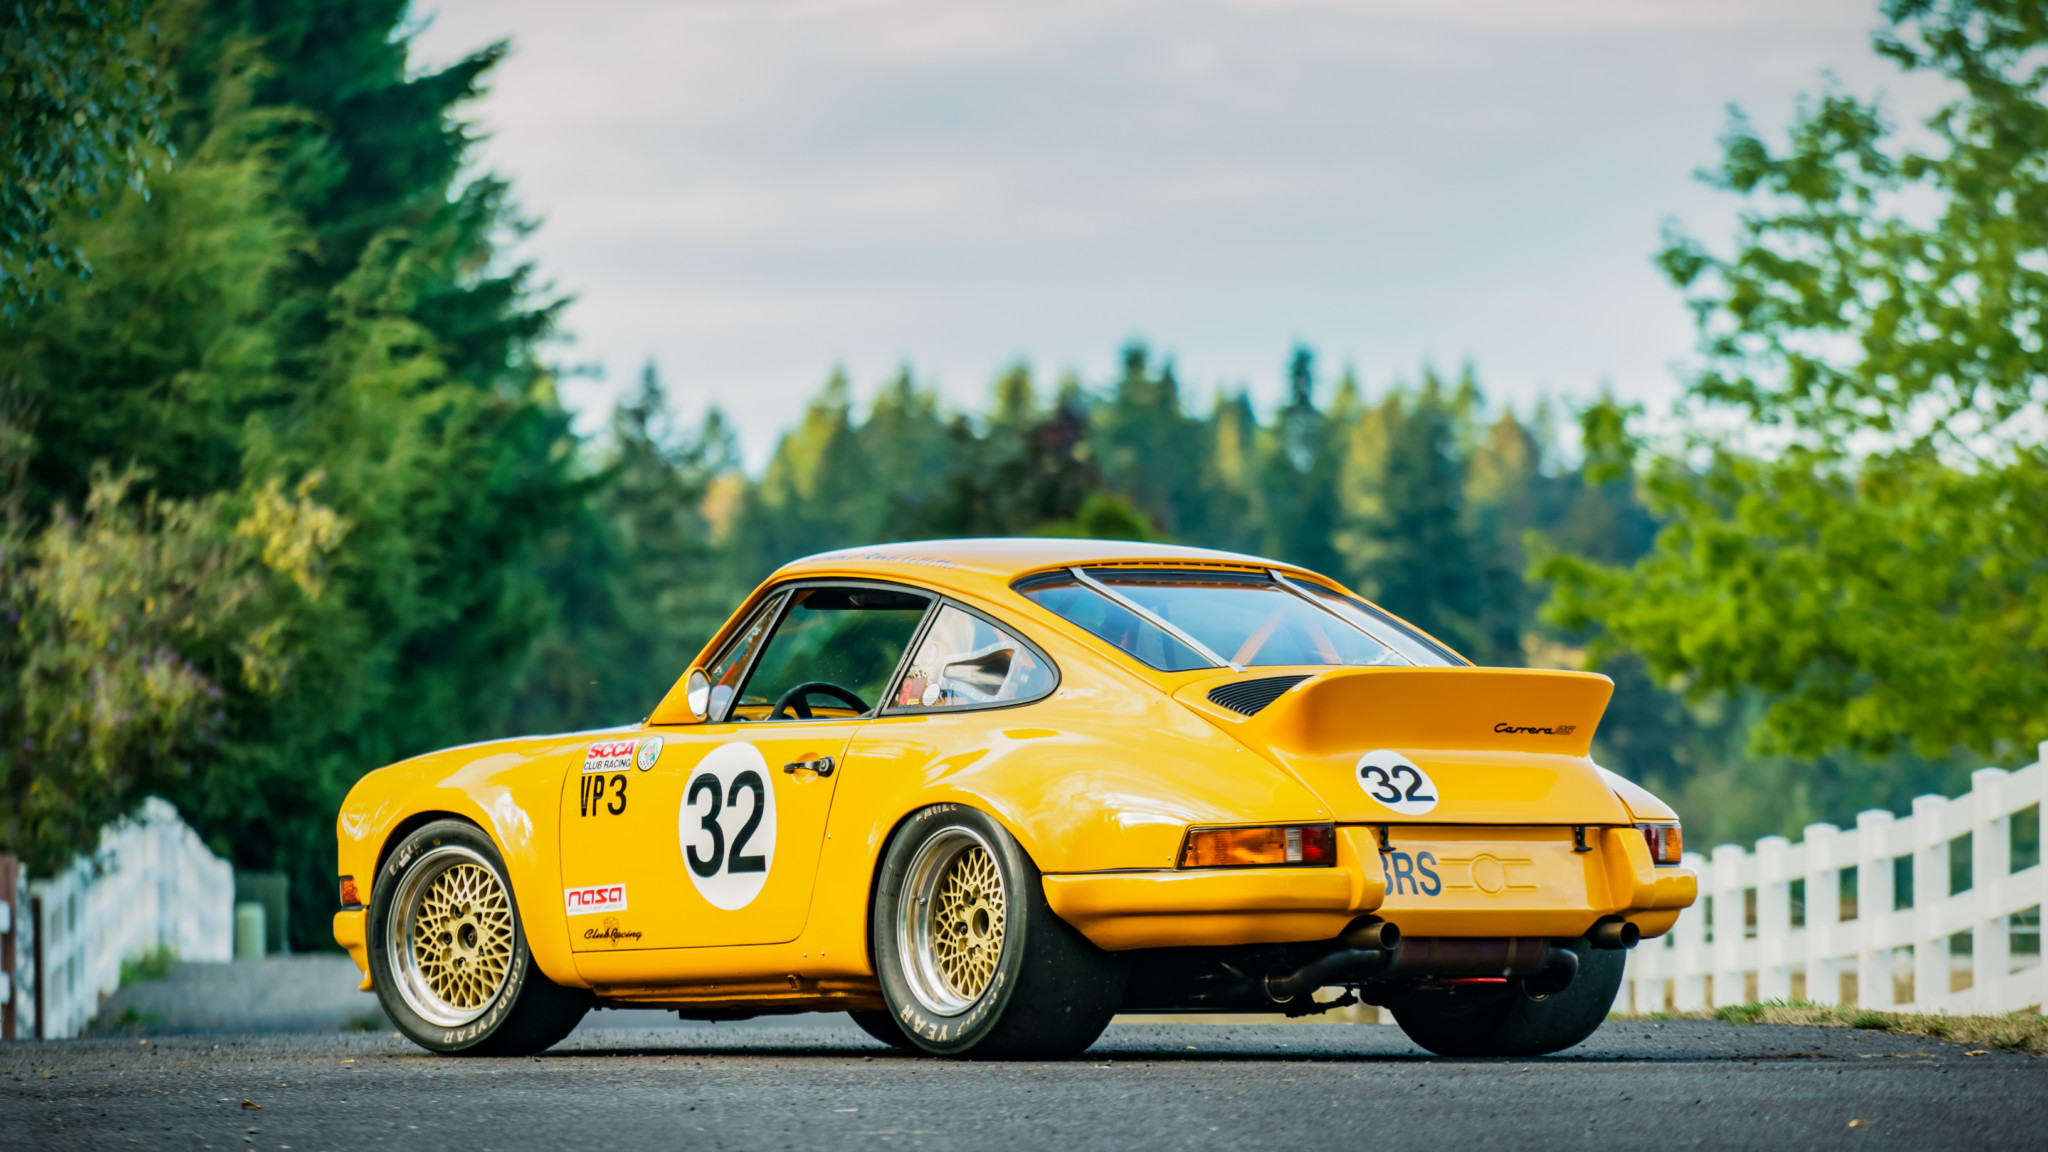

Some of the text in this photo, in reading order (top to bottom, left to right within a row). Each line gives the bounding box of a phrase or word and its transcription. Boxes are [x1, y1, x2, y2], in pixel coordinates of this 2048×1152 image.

[1494, 723, 1553, 735] Carrera
[588, 742, 636, 759] SCCA
[583, 758, 631, 771] CLUB RACING
[1360, 765, 1436, 804] 32
[686, 770, 766, 878] 32
[568, 887, 622, 907] nasa
[584, 927, 643, 942] Club Racing
